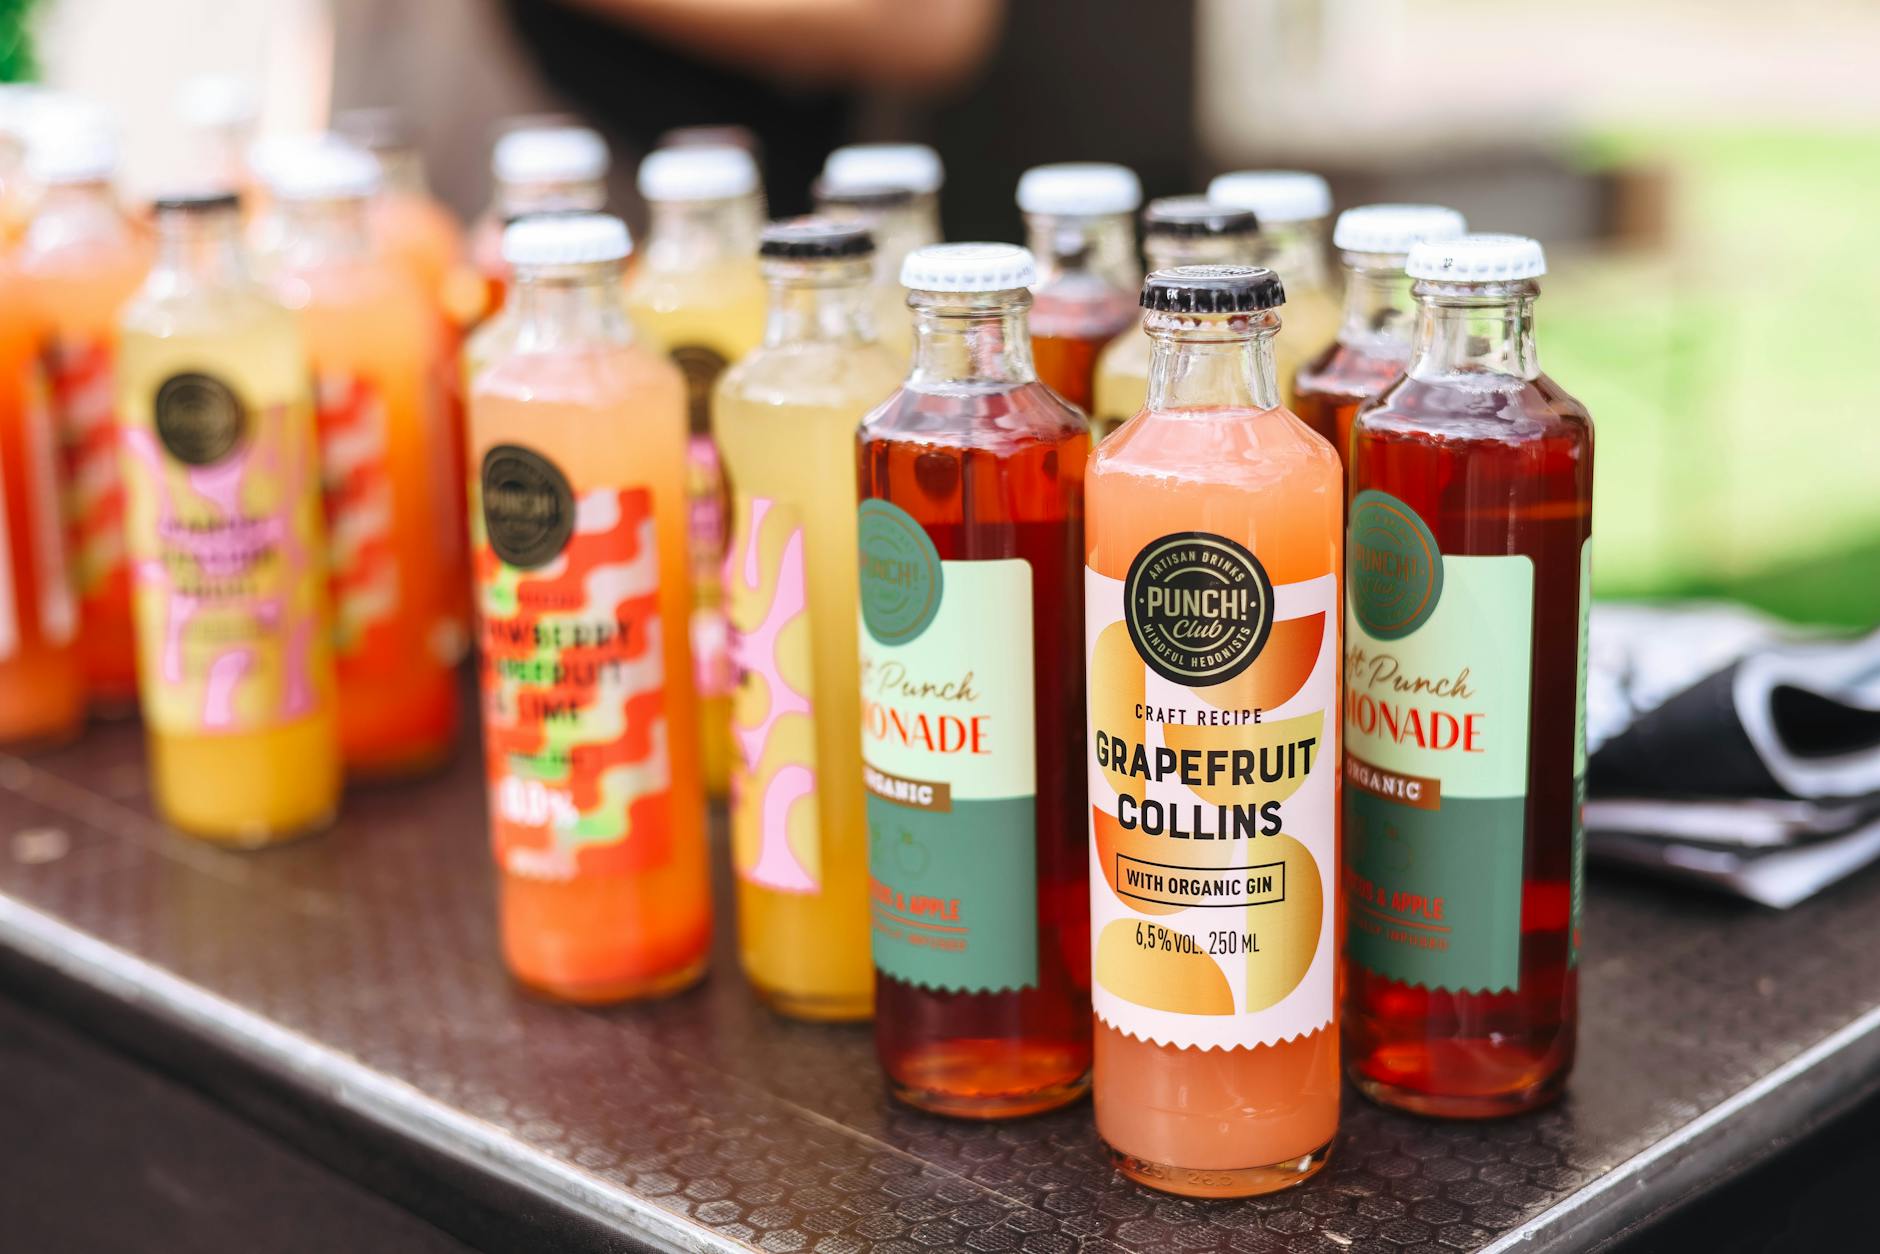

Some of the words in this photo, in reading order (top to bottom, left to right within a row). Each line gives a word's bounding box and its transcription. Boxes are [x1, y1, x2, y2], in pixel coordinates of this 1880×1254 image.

[1149, 551, 1197, 580] ARTISAN
[1202, 551, 1246, 584] DRINKS
[1147, 586, 1248, 621] PUNCH!
[1143, 623, 1186, 667] MINDFUL
[1190, 626, 1251, 668] HEDONISTS
[1172, 618, 1224, 640] Club
[879, 660, 980, 701] Punch
[1368, 654, 1477, 700] Punch
[1135, 703, 1187, 726] CRAFT
[1197, 707, 1263, 726] RECIPE
[1345, 685, 1485, 753] MONADE
[1096, 729, 1317, 787] GRAPEFRUIT
[1117, 793, 1283, 841] COLLINS
[1126, 868, 1164, 893] WITH
[1167, 876, 1242, 897] ORGANIC
[1246, 875, 1273, 895] GIN
[1391, 889, 1445, 922] APPLE
[1208, 930, 1238, 956] 250
[1241, 933, 1261, 954] ML
